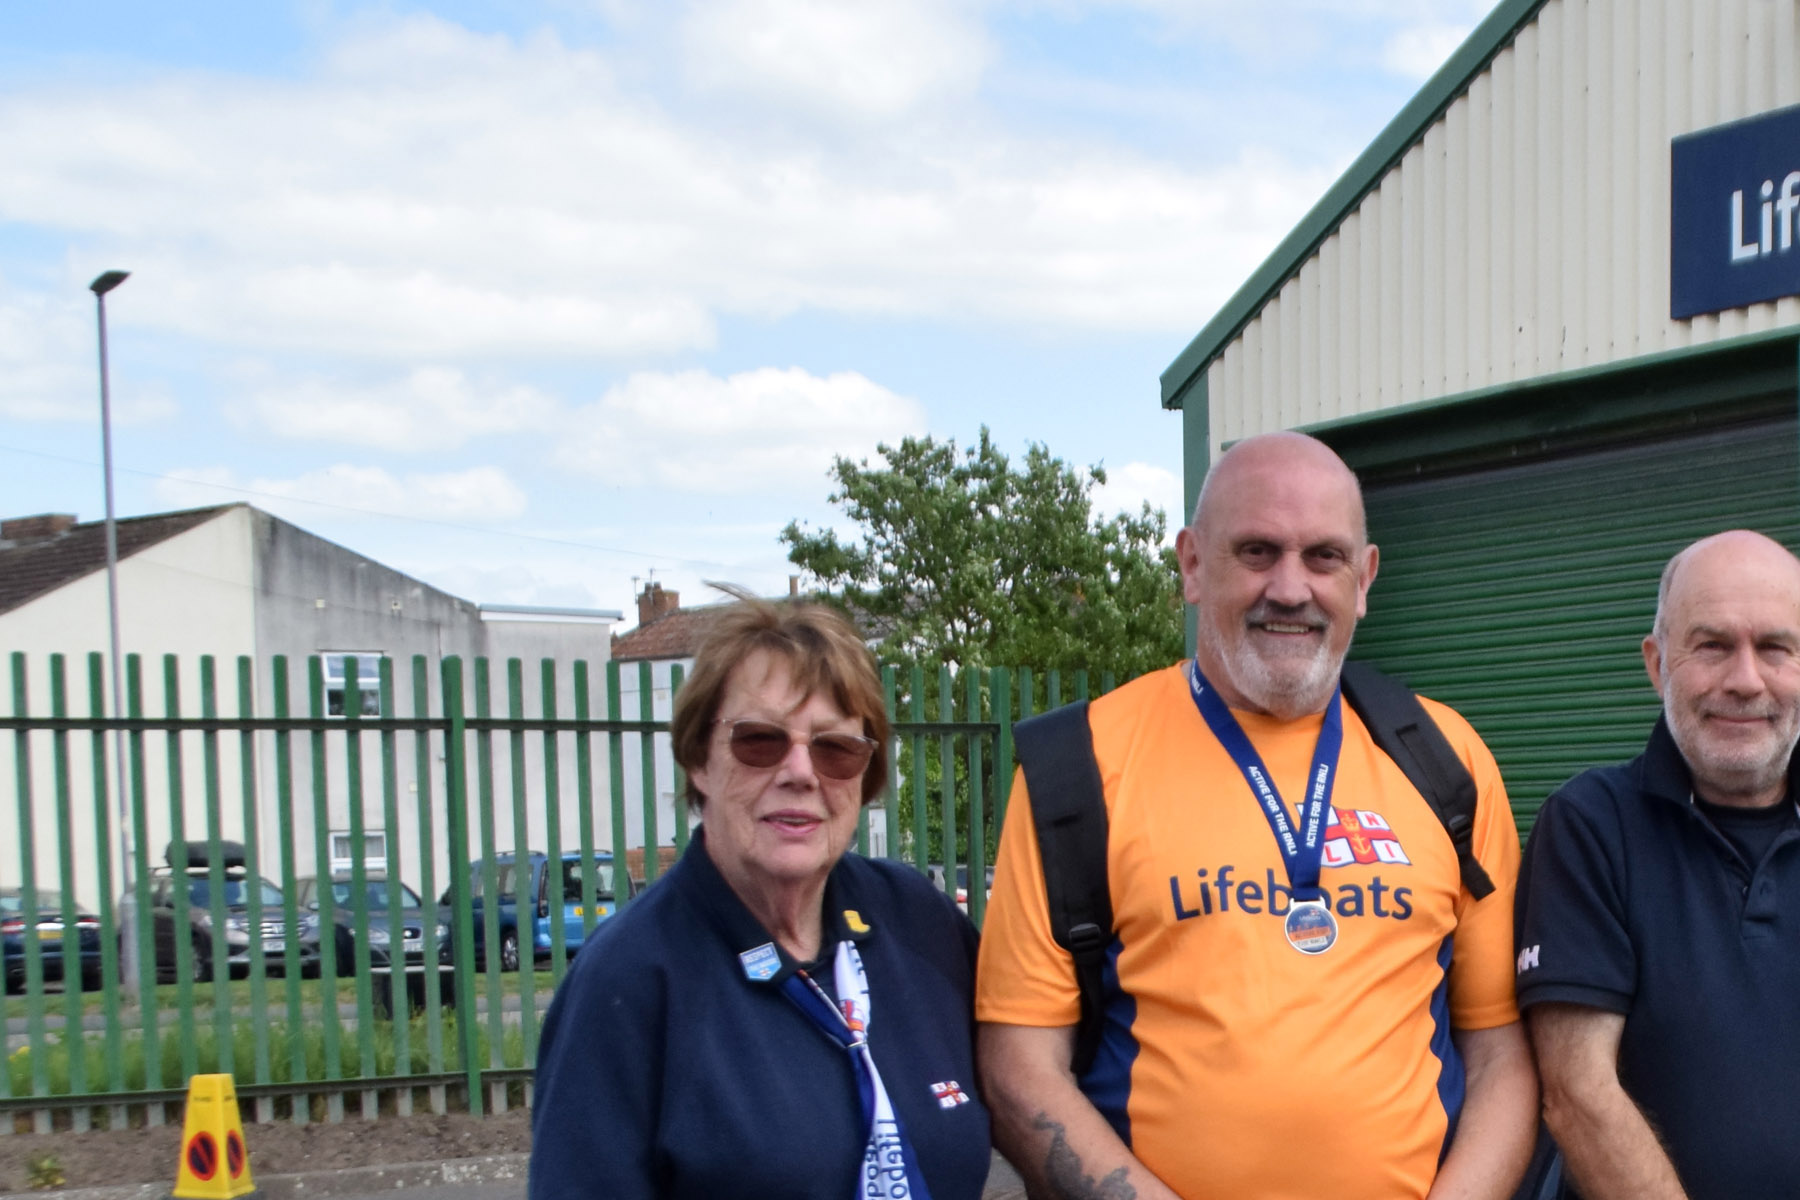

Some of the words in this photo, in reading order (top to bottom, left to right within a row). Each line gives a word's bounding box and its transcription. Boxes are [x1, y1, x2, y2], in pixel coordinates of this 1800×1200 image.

[1318, 763, 1329, 783] RNLI
[1314, 782, 1326, 800] THE
[1248, 766, 1271, 795] ACTIVE
[1264, 794, 1280, 813] FOR
[1275, 812, 1289, 832] THE
[1282, 832, 1298, 855] RNLI
[1311, 801, 1322, 818] FOR
[1306, 818, 1319, 848] ACTIVE
